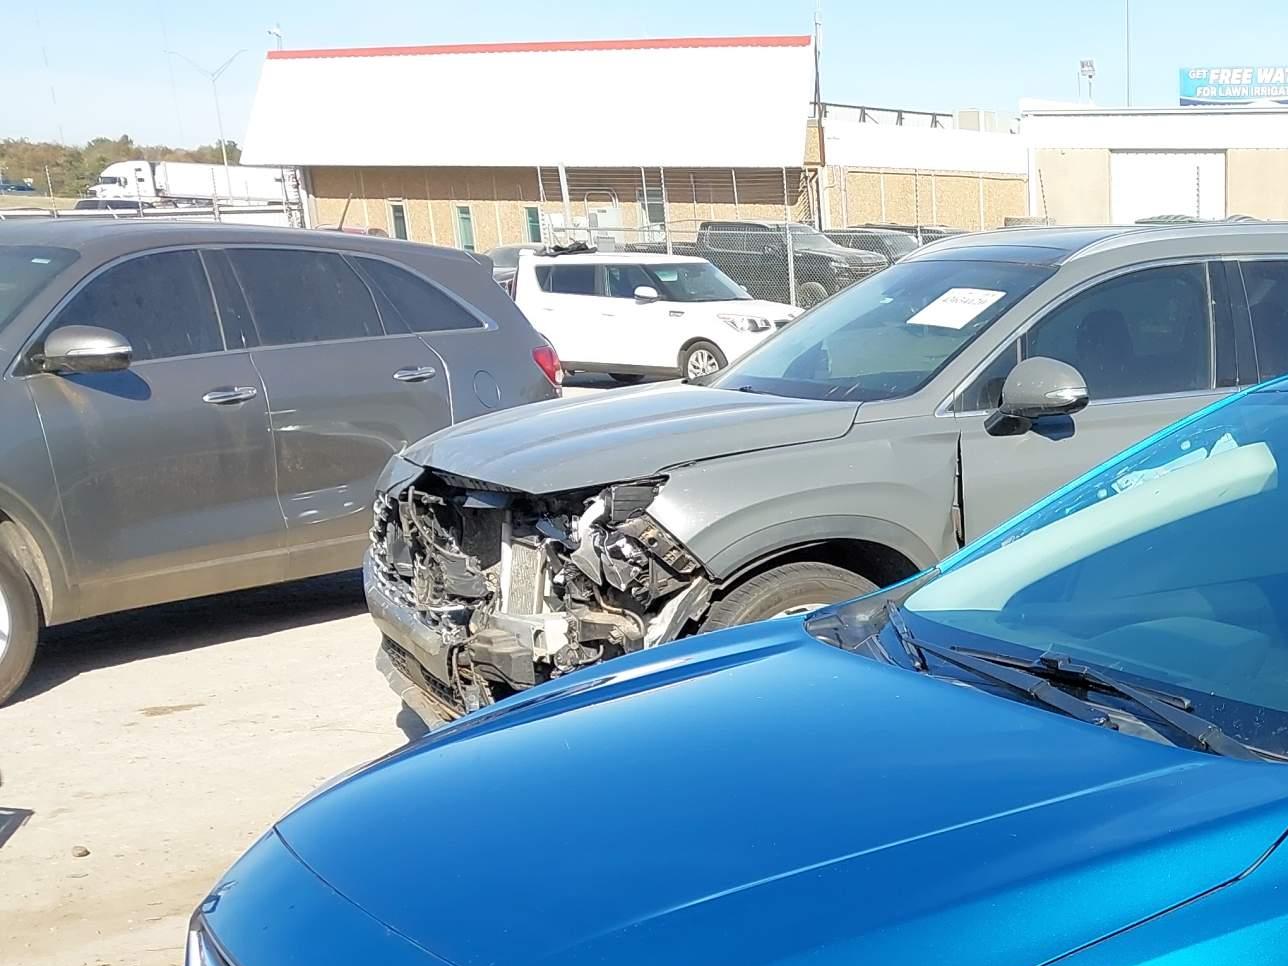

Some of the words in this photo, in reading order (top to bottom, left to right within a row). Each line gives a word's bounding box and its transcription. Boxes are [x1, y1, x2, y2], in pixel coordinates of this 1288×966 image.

[1188, 69, 1208, 80] GET
[1208, 67, 1253, 84] FREE
[1196, 86, 1217, 97] FOR
[1218, 86, 1248, 97] LAWN
